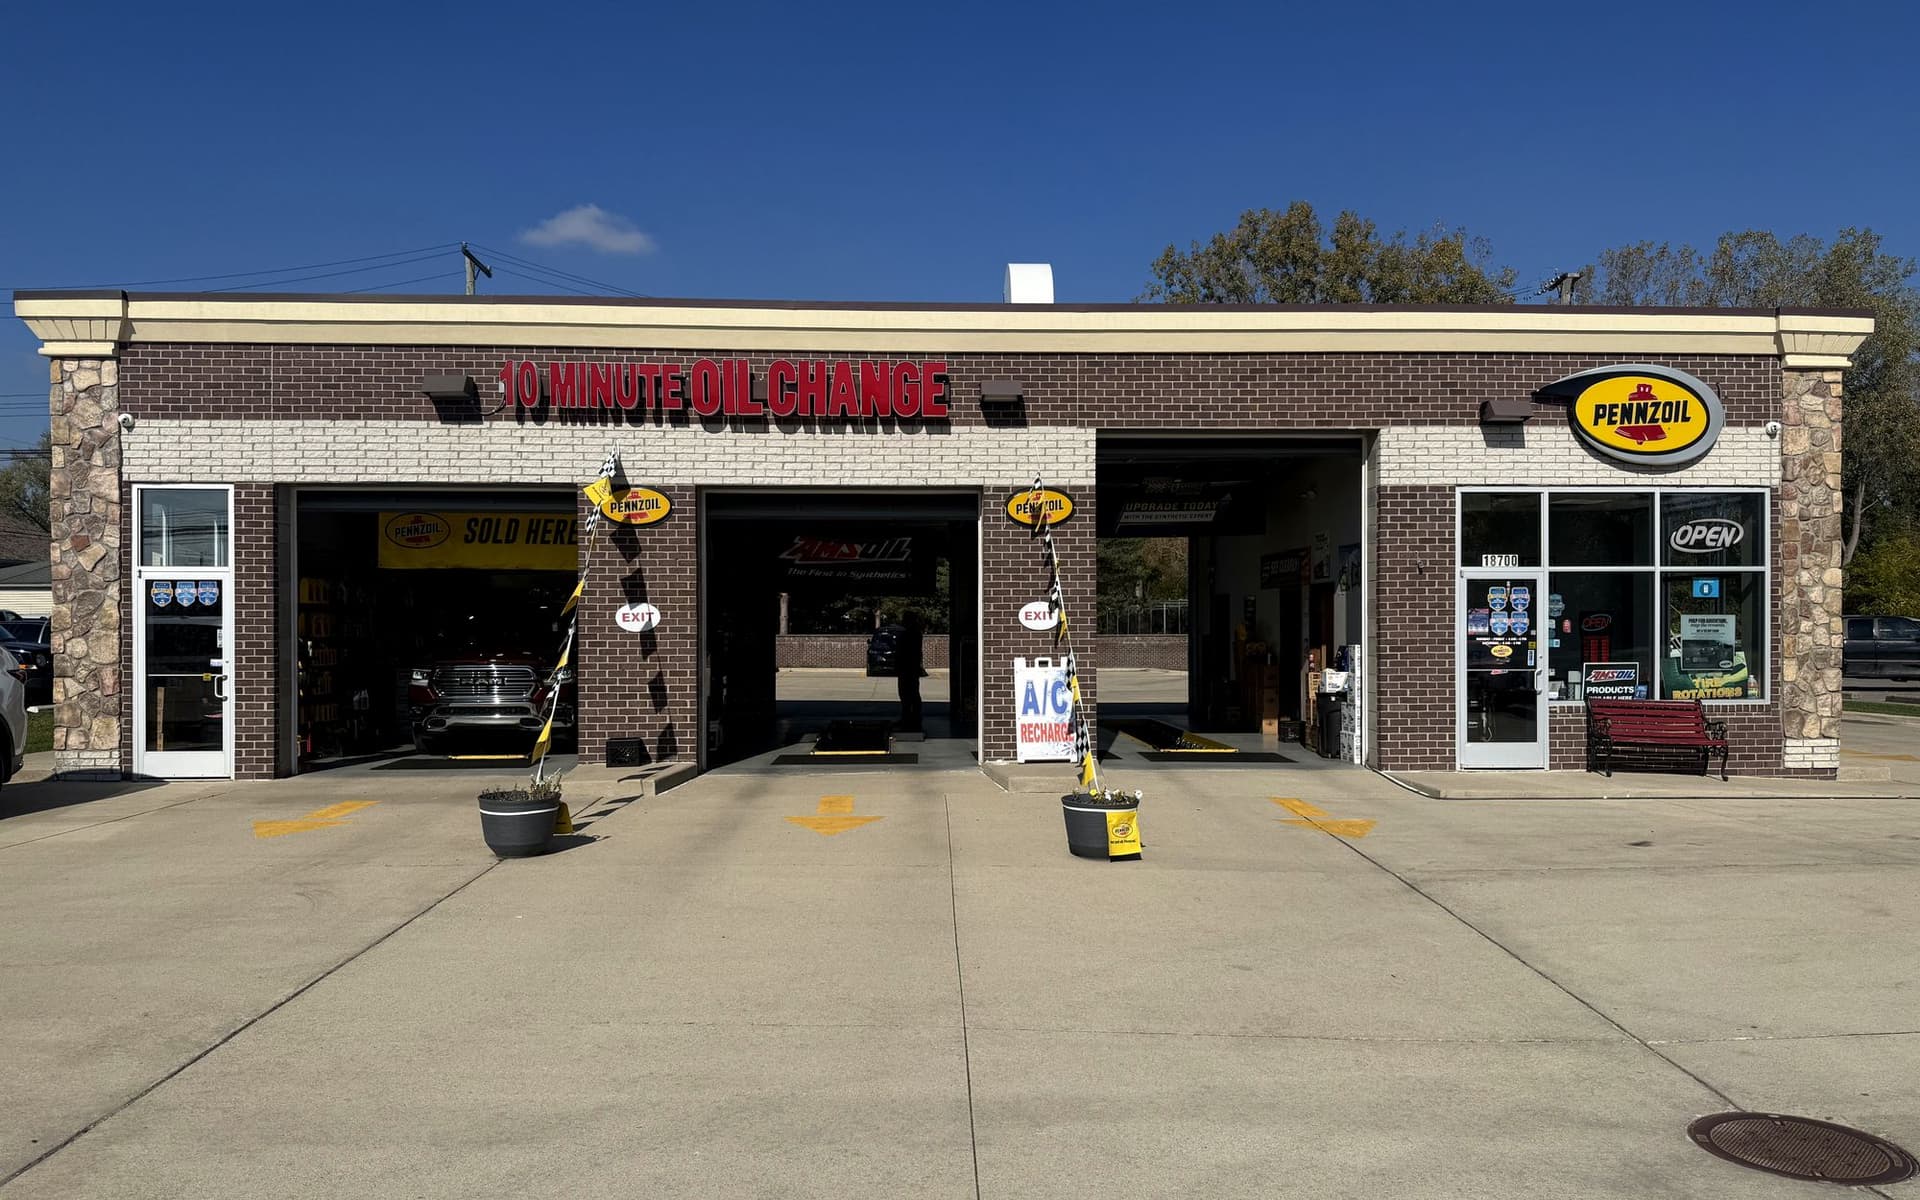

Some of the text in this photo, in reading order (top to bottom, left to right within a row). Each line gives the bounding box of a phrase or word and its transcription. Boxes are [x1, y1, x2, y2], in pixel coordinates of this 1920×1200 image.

[499, 358, 949, 417] 10 MINUTE OIL CHANGE
[1593, 400, 1691, 426] PENNZOIL
[610, 498, 661, 513] PENNZOIL
[1125, 501, 1218, 512] UPGRADE TODAY
[394, 523, 441, 538] PENNZOIL
[463, 517, 578, 545] SOLD HERE
[1675, 525, 1736, 547] OPEN
[1484, 555, 1517, 567] 18700
[622, 612, 654, 622] EXIT
[1586, 669, 1635, 682] AMSOIL
[1586, 685, 1634, 694] PRODUCTS
[1672, 687, 1742, 700] ROTATIONS
[1022, 680, 1068, 715] A/C
